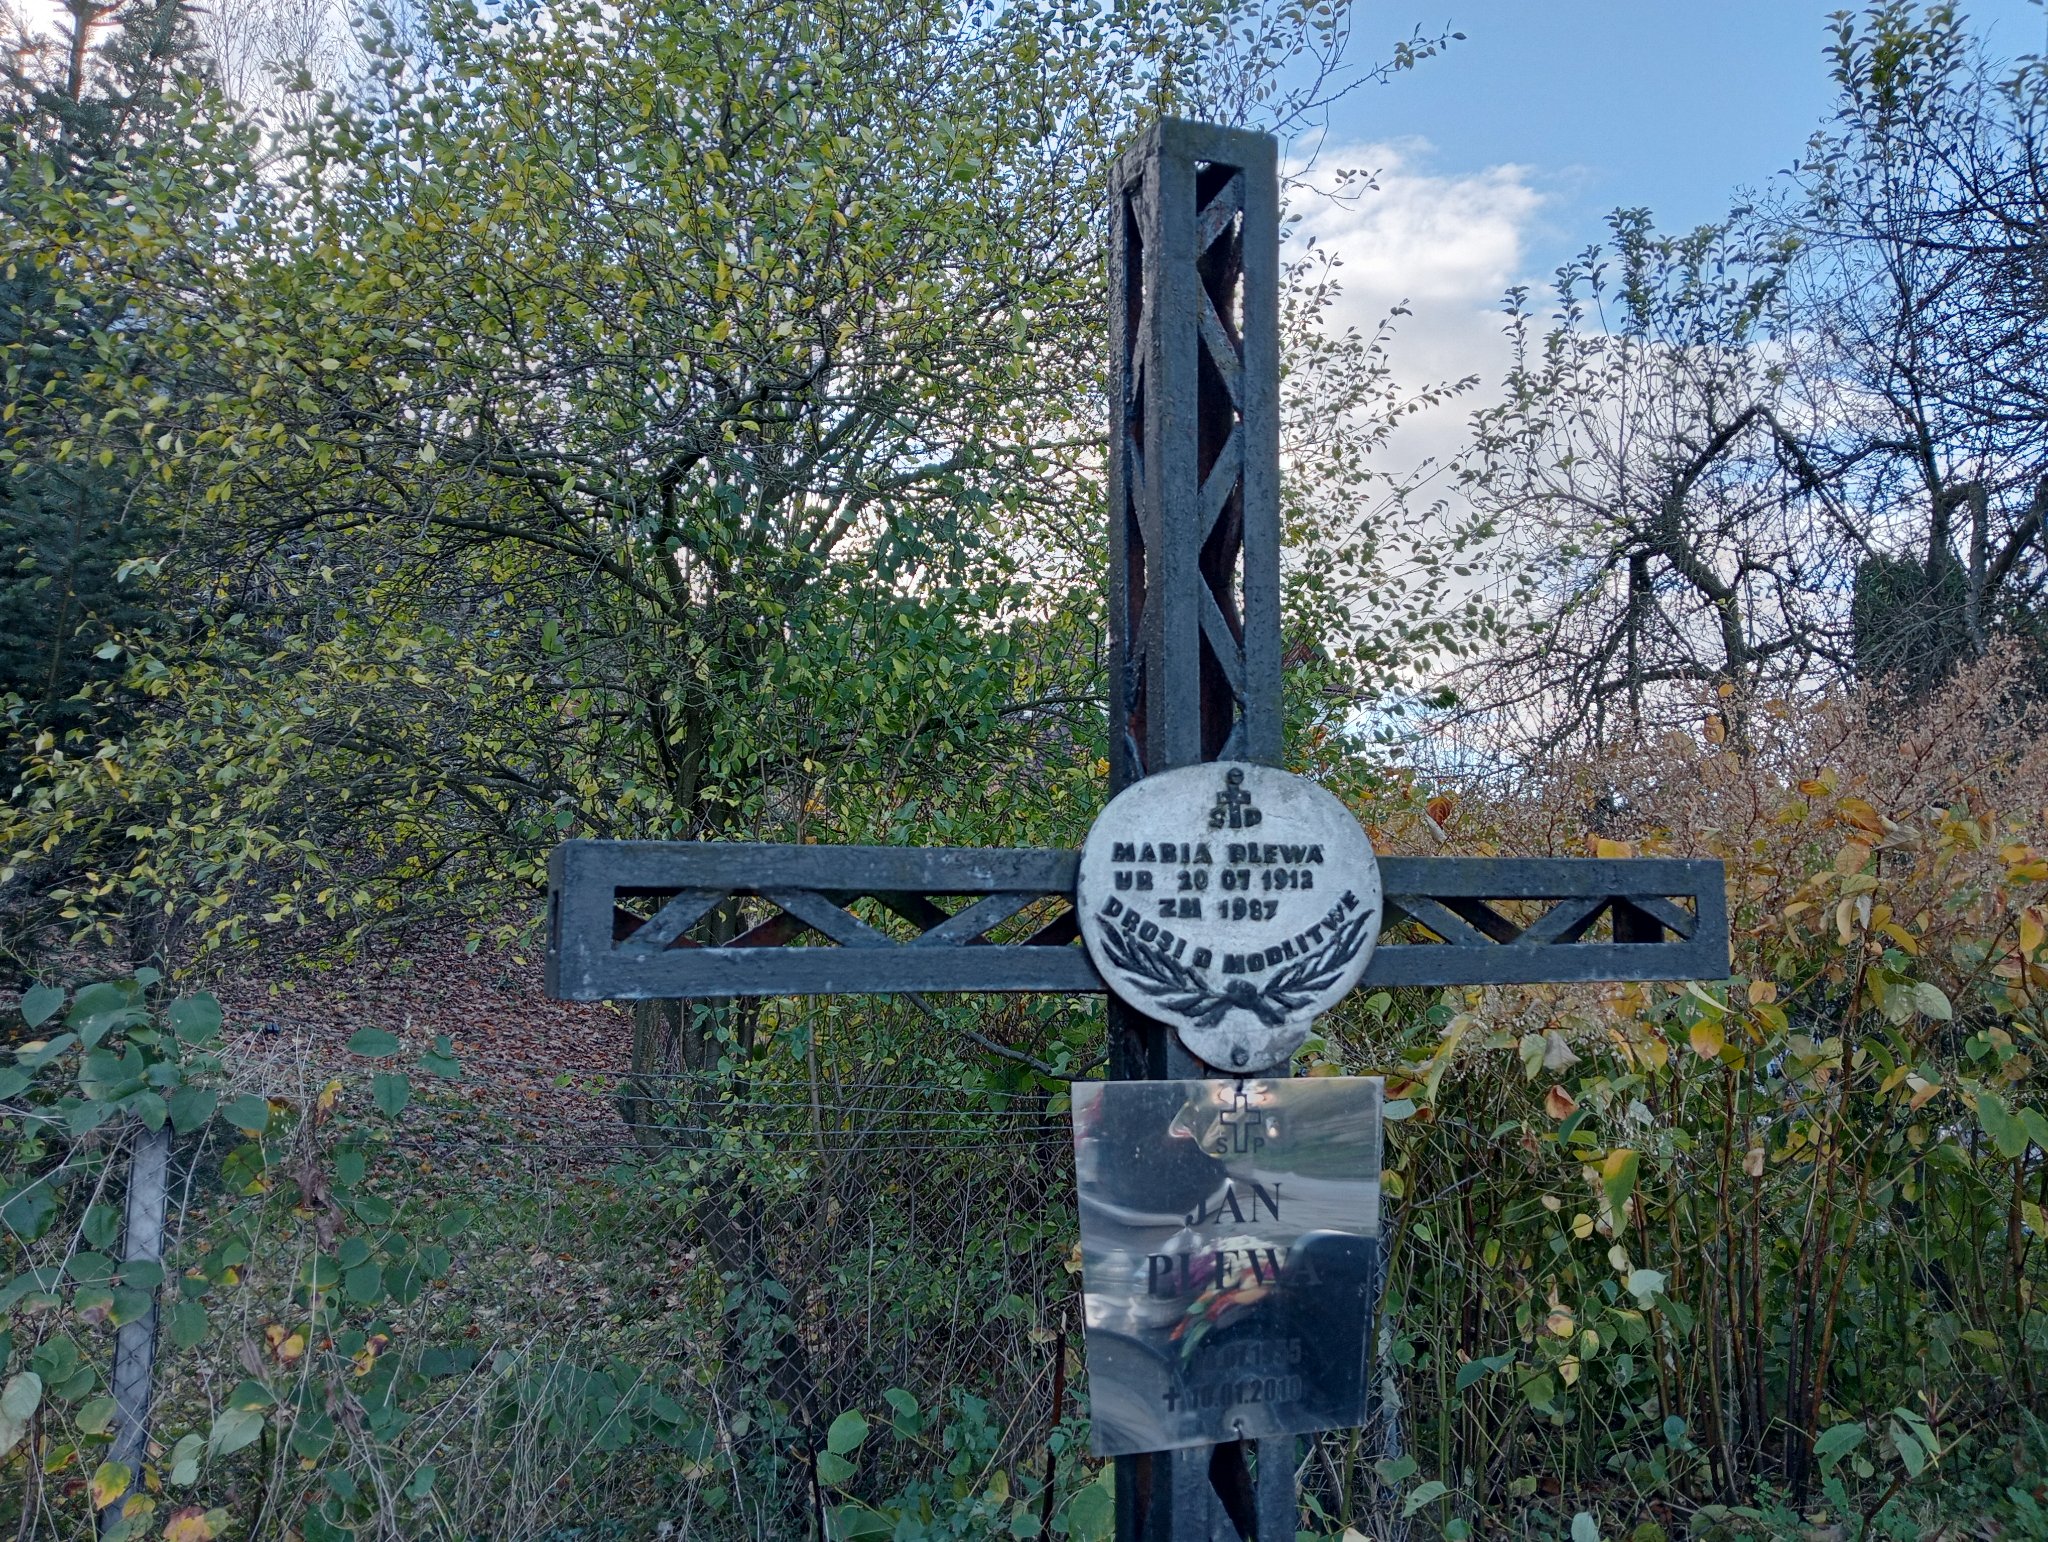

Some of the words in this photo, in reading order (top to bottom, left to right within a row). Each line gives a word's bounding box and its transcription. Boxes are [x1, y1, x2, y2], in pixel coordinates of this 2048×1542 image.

[1111, 841, 1213, 864] MARIA
[1227, 841, 1325, 864] PLEWA
[1114, 870, 1154, 891] UR
[1177, 868, 1208, 891] 20
[1220, 869, 1251, 891] 07
[1261, 867, 1314, 891] 1912
[1218, 896, 1279, 921] 1987
[1254, 1137, 1265, 1154] P
[1184, 1182, 1282, 1226] JAN
[1146, 1247, 1323, 1296] PLEWA
